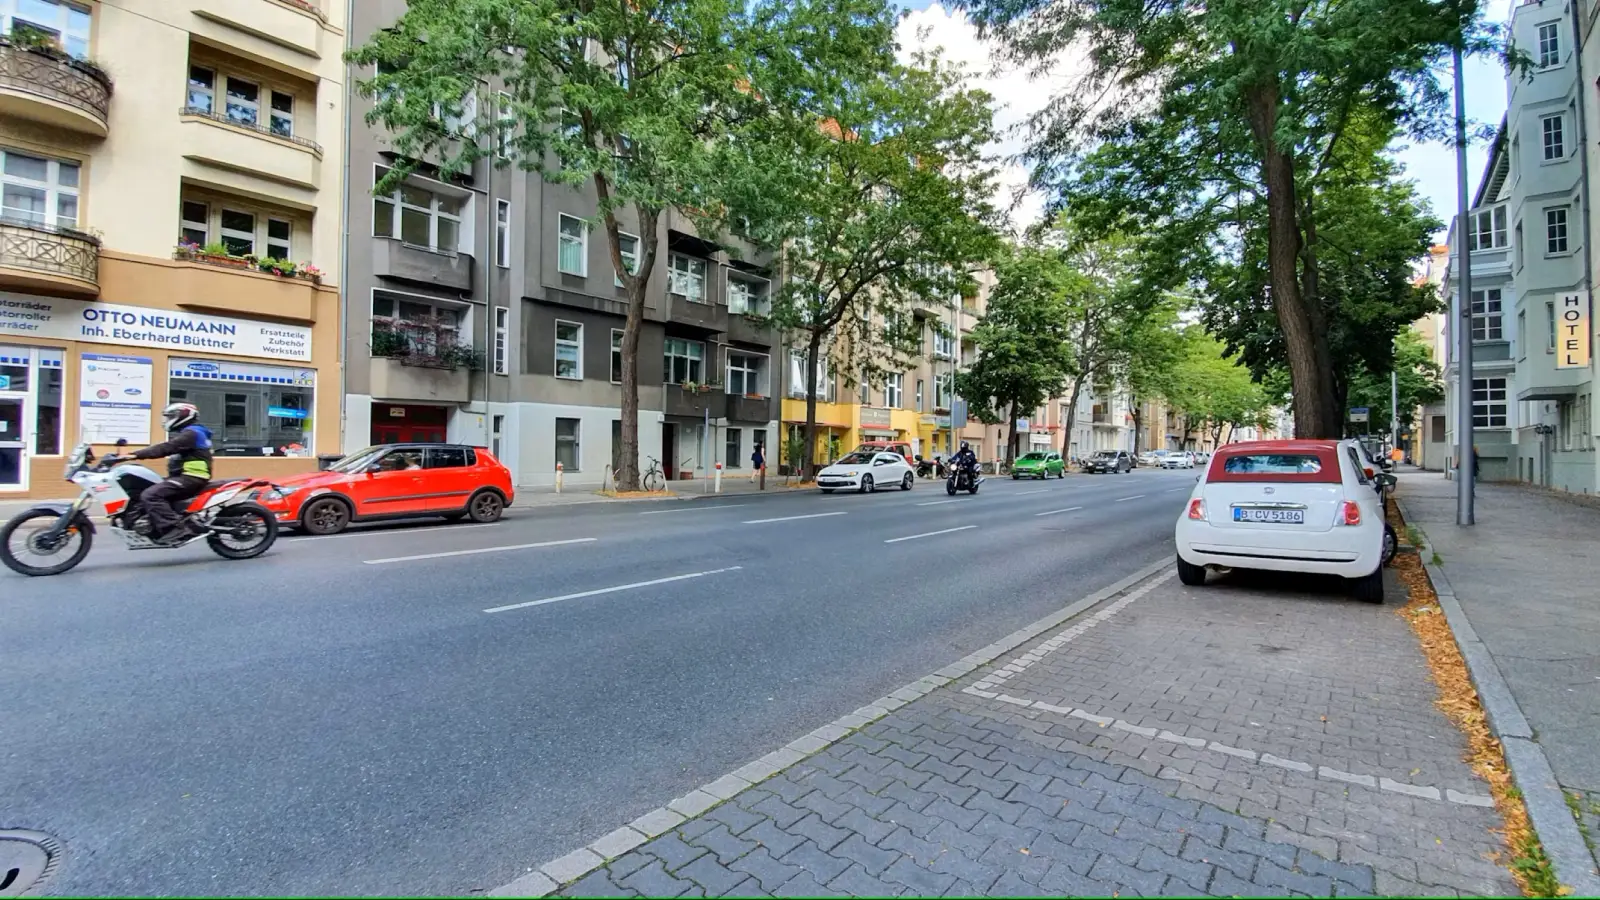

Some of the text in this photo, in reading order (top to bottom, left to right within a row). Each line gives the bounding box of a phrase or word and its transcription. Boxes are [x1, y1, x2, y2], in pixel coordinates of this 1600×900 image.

[0, 321, 39, 331] rräder
[83, 308, 236, 336] OTTO NEUMANN
[260, 328, 305, 340] Ersatzteile
[1564, 296, 1580, 365] HOTEL
[82, 325, 235, 349] Inh. Eberhard Büttner
[268, 338, 305, 348] Zubehör
[262, 345, 305, 356] Werkstatt
[1241, 510, 1301, 520] B CV 5186
